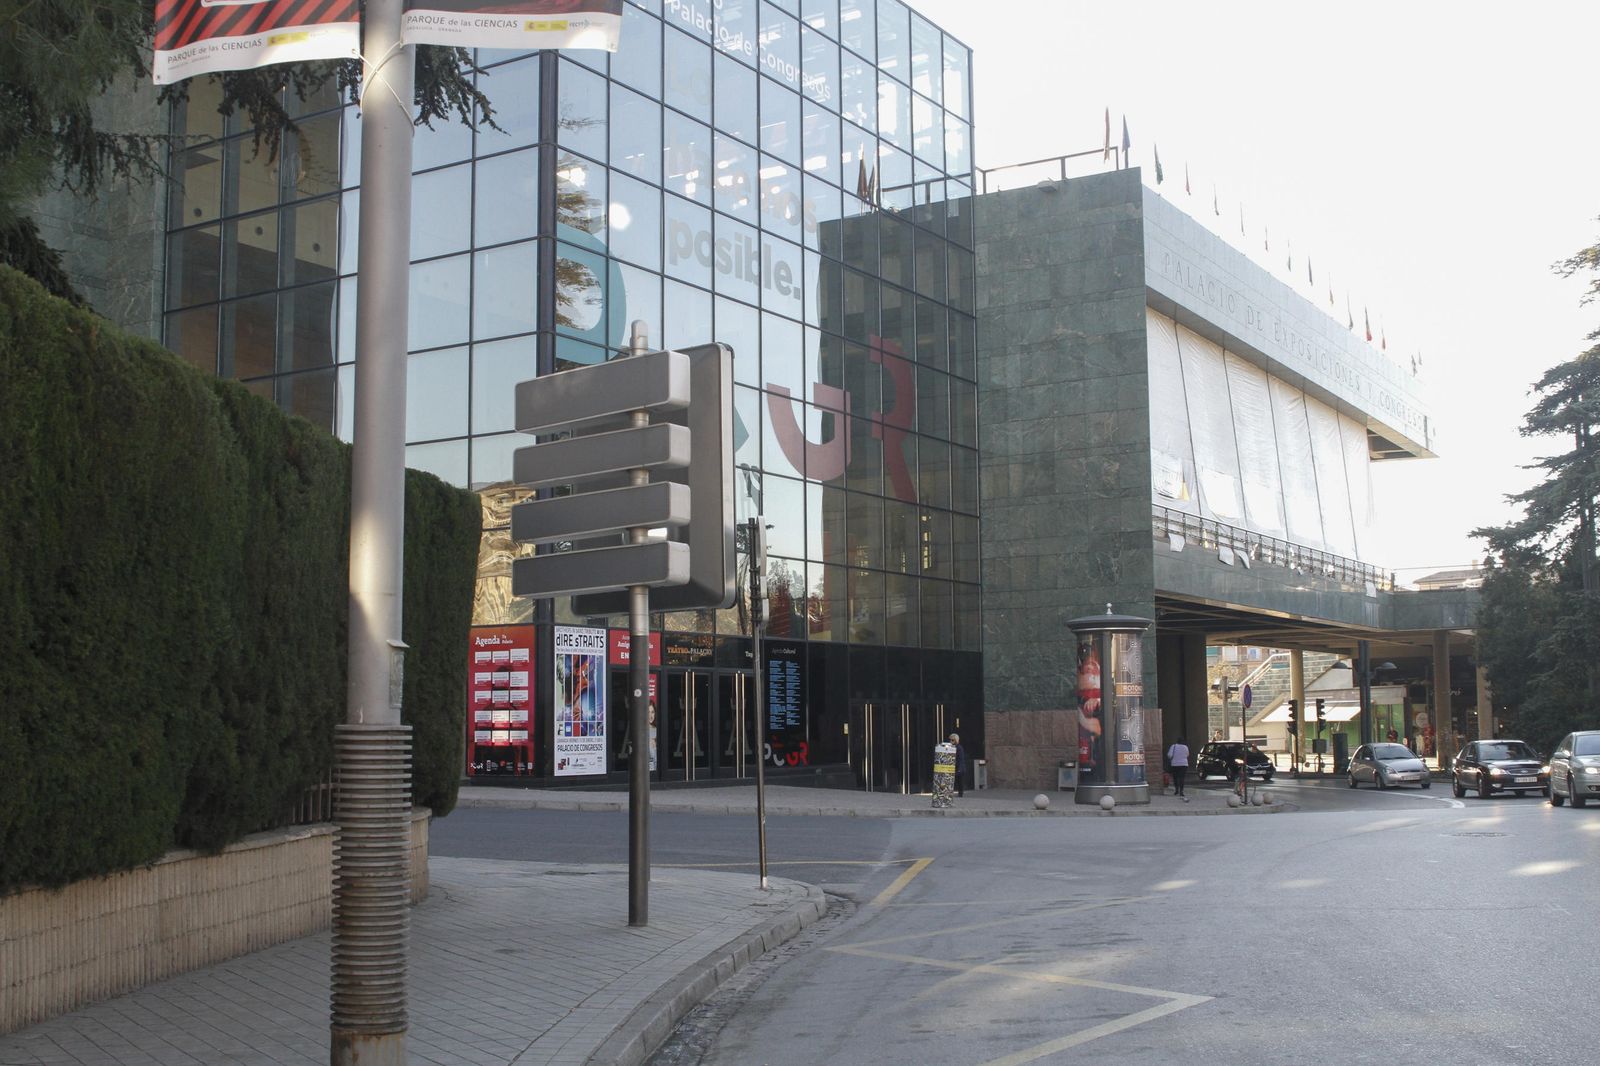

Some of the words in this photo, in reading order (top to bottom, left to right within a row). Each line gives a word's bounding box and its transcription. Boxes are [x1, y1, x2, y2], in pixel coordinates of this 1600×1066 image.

[406, 15, 446, 25] PARQUE
[448, 18, 459, 26] de
[460, 18, 472, 27] las
[474, 18, 519, 28] CIENCIAS
[167, 48, 197, 64] PARQUE
[198, 46, 207, 55] de
[208, 44, 220, 53] las
[221, 38, 263, 51] CIENCIAS
[668, 217, 801, 300] posible.
[1163, 251, 1237, 315] PALACIO
[1246, 304, 1265, 332] DE
[1273, 317, 1361, 393] EXPOSICIONES
[1378, 390, 1426, 431] CONGRESO
[475, 634, 501, 648] Agenda
